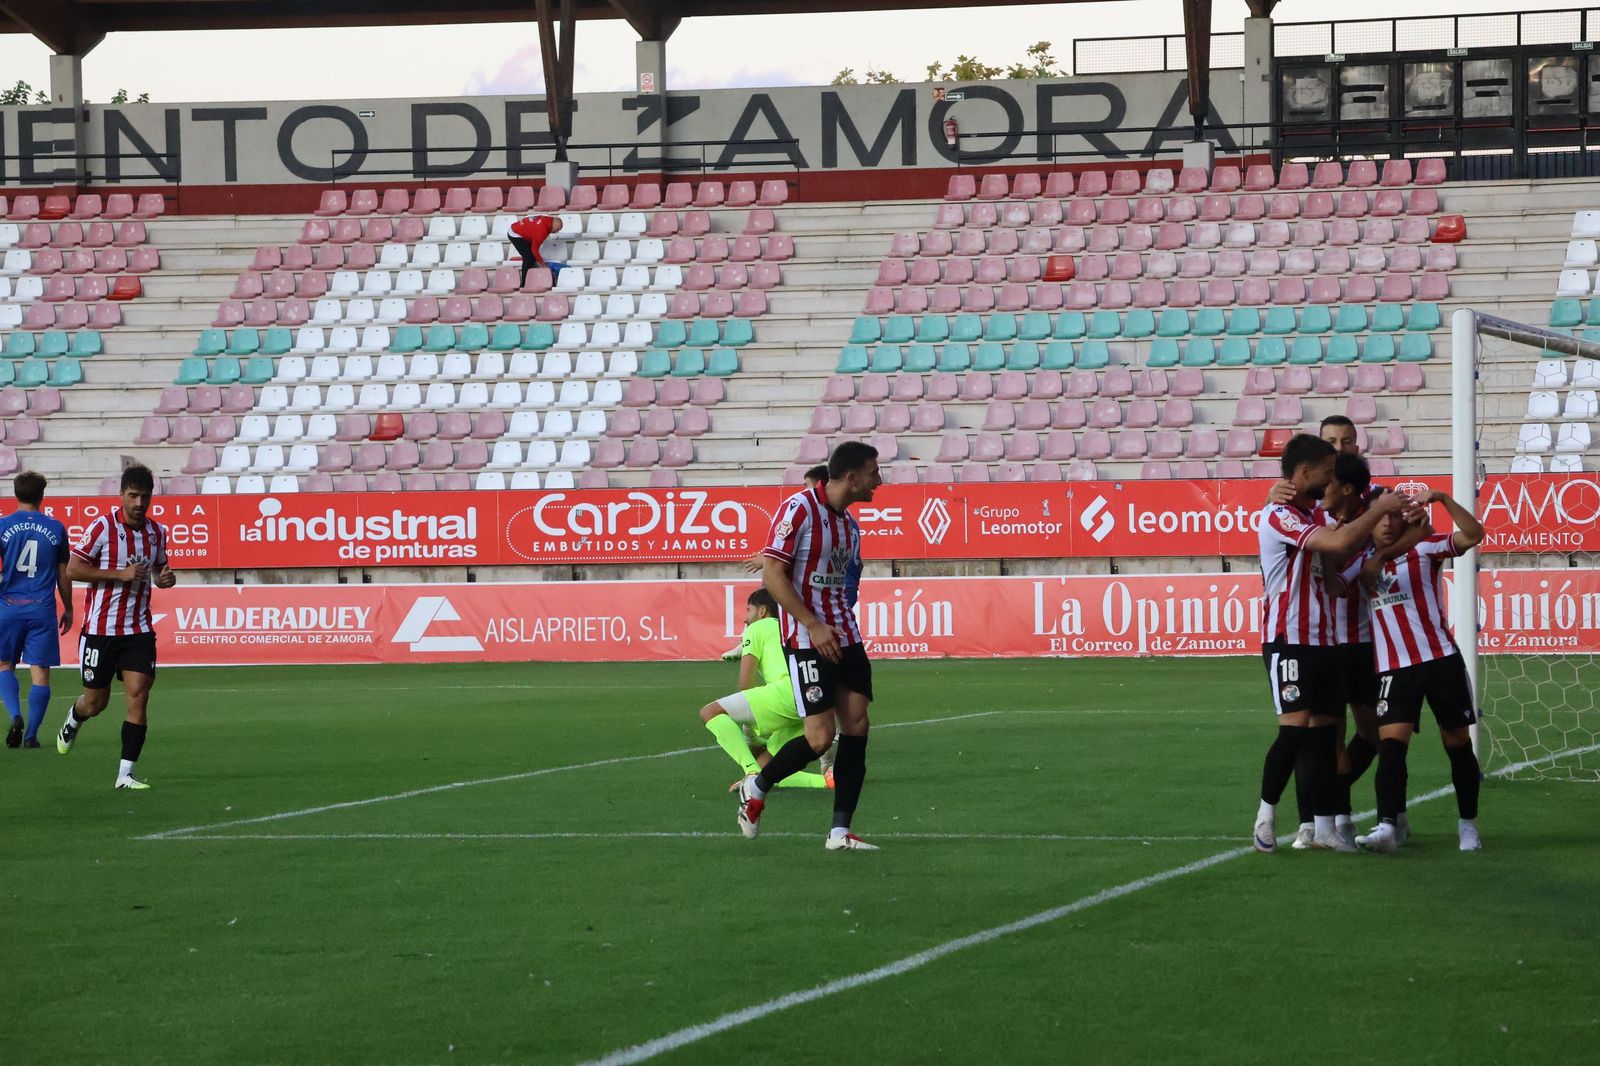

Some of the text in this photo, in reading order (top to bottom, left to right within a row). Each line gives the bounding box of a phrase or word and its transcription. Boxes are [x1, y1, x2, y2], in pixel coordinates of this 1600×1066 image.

[411, 99, 577, 182] DE
[622, 77, 1240, 172] ZAMORA
[240, 503, 477, 541] la industrial
[980, 505, 1020, 521] Grupo
[2, 522, 59, 546] ENTRECANALES
[981, 520, 1062, 534] Leomotor
[338, 541, 478, 563] de pinturas
[533, 538, 748, 552] EMBUTIDOS Y JAMONES
[16, 539, 39, 578] 4
[174, 606, 371, 630] VALDERADUEY
[1033, 581, 1264, 653] La Opinión
[175, 634, 372, 644] EL CENTRO COMERCIAL DE ZAMORA
[485, 616, 678, 645] AISLAPRIETO, S.L.
[1478, 632, 1578, 647] de Zamora
[862, 639, 929, 653] Zamora
[1050, 635, 1246, 652] El Correo de Zamora
[84, 648, 99, 668] 20
[798, 659, 820, 685] 16
[1279, 659, 1299, 682] 18
[1379, 675, 1394, 699] 17
